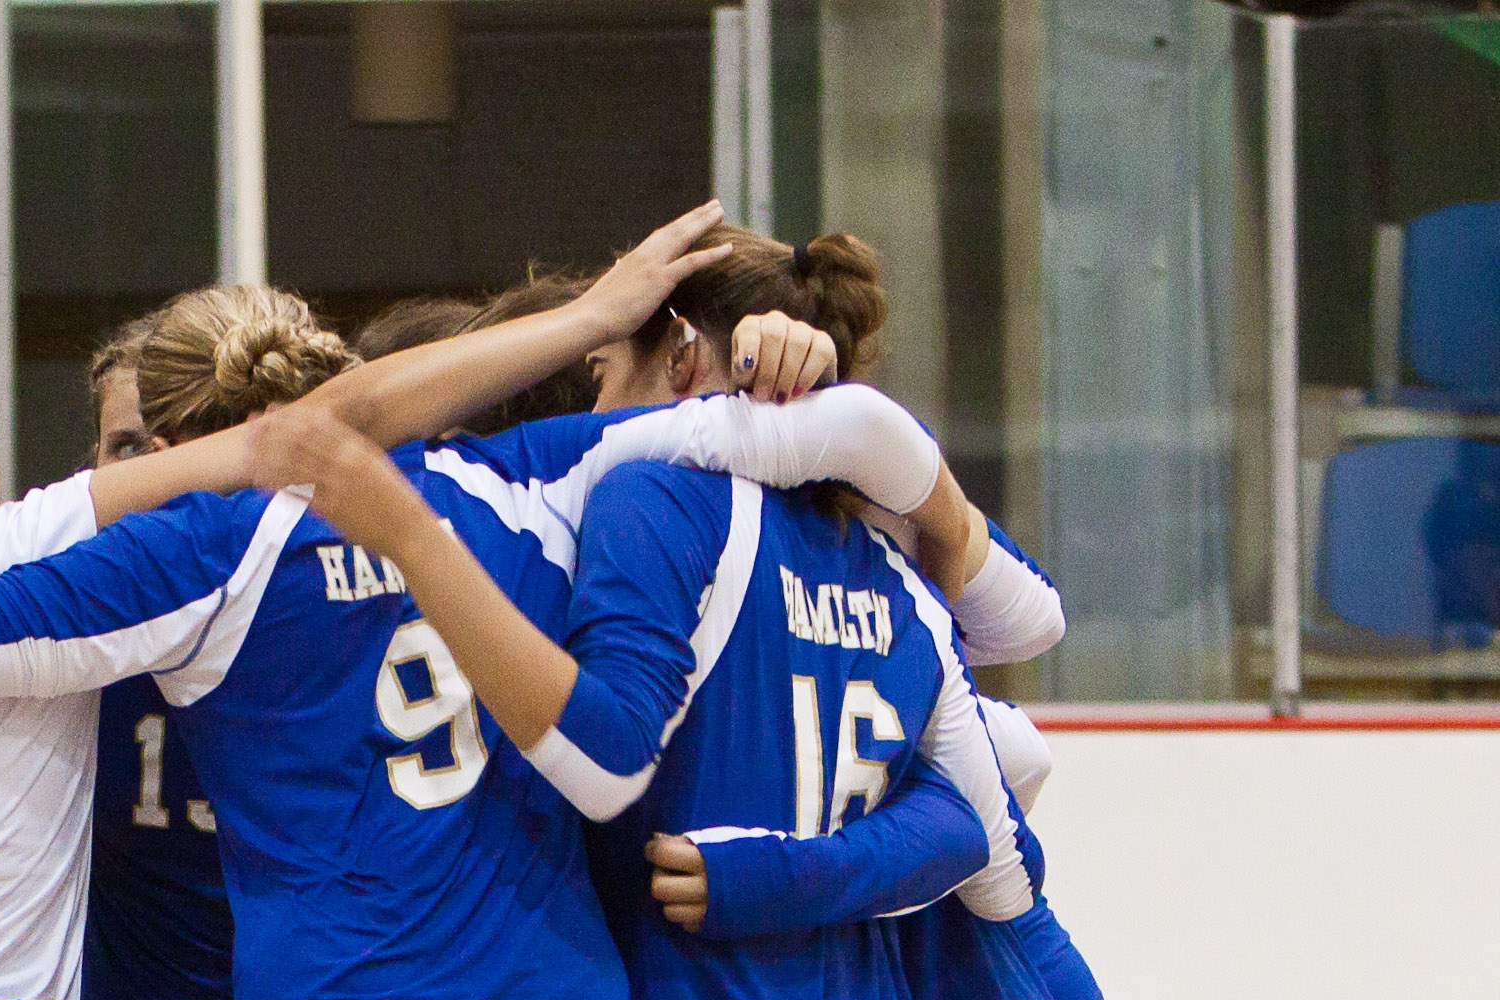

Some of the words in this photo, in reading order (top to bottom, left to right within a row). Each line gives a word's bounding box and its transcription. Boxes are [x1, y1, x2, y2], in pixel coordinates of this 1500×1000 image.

[132, 714, 218, 833] 1
[376, 618, 489, 810] 9
[791, 674, 906, 839] 16
